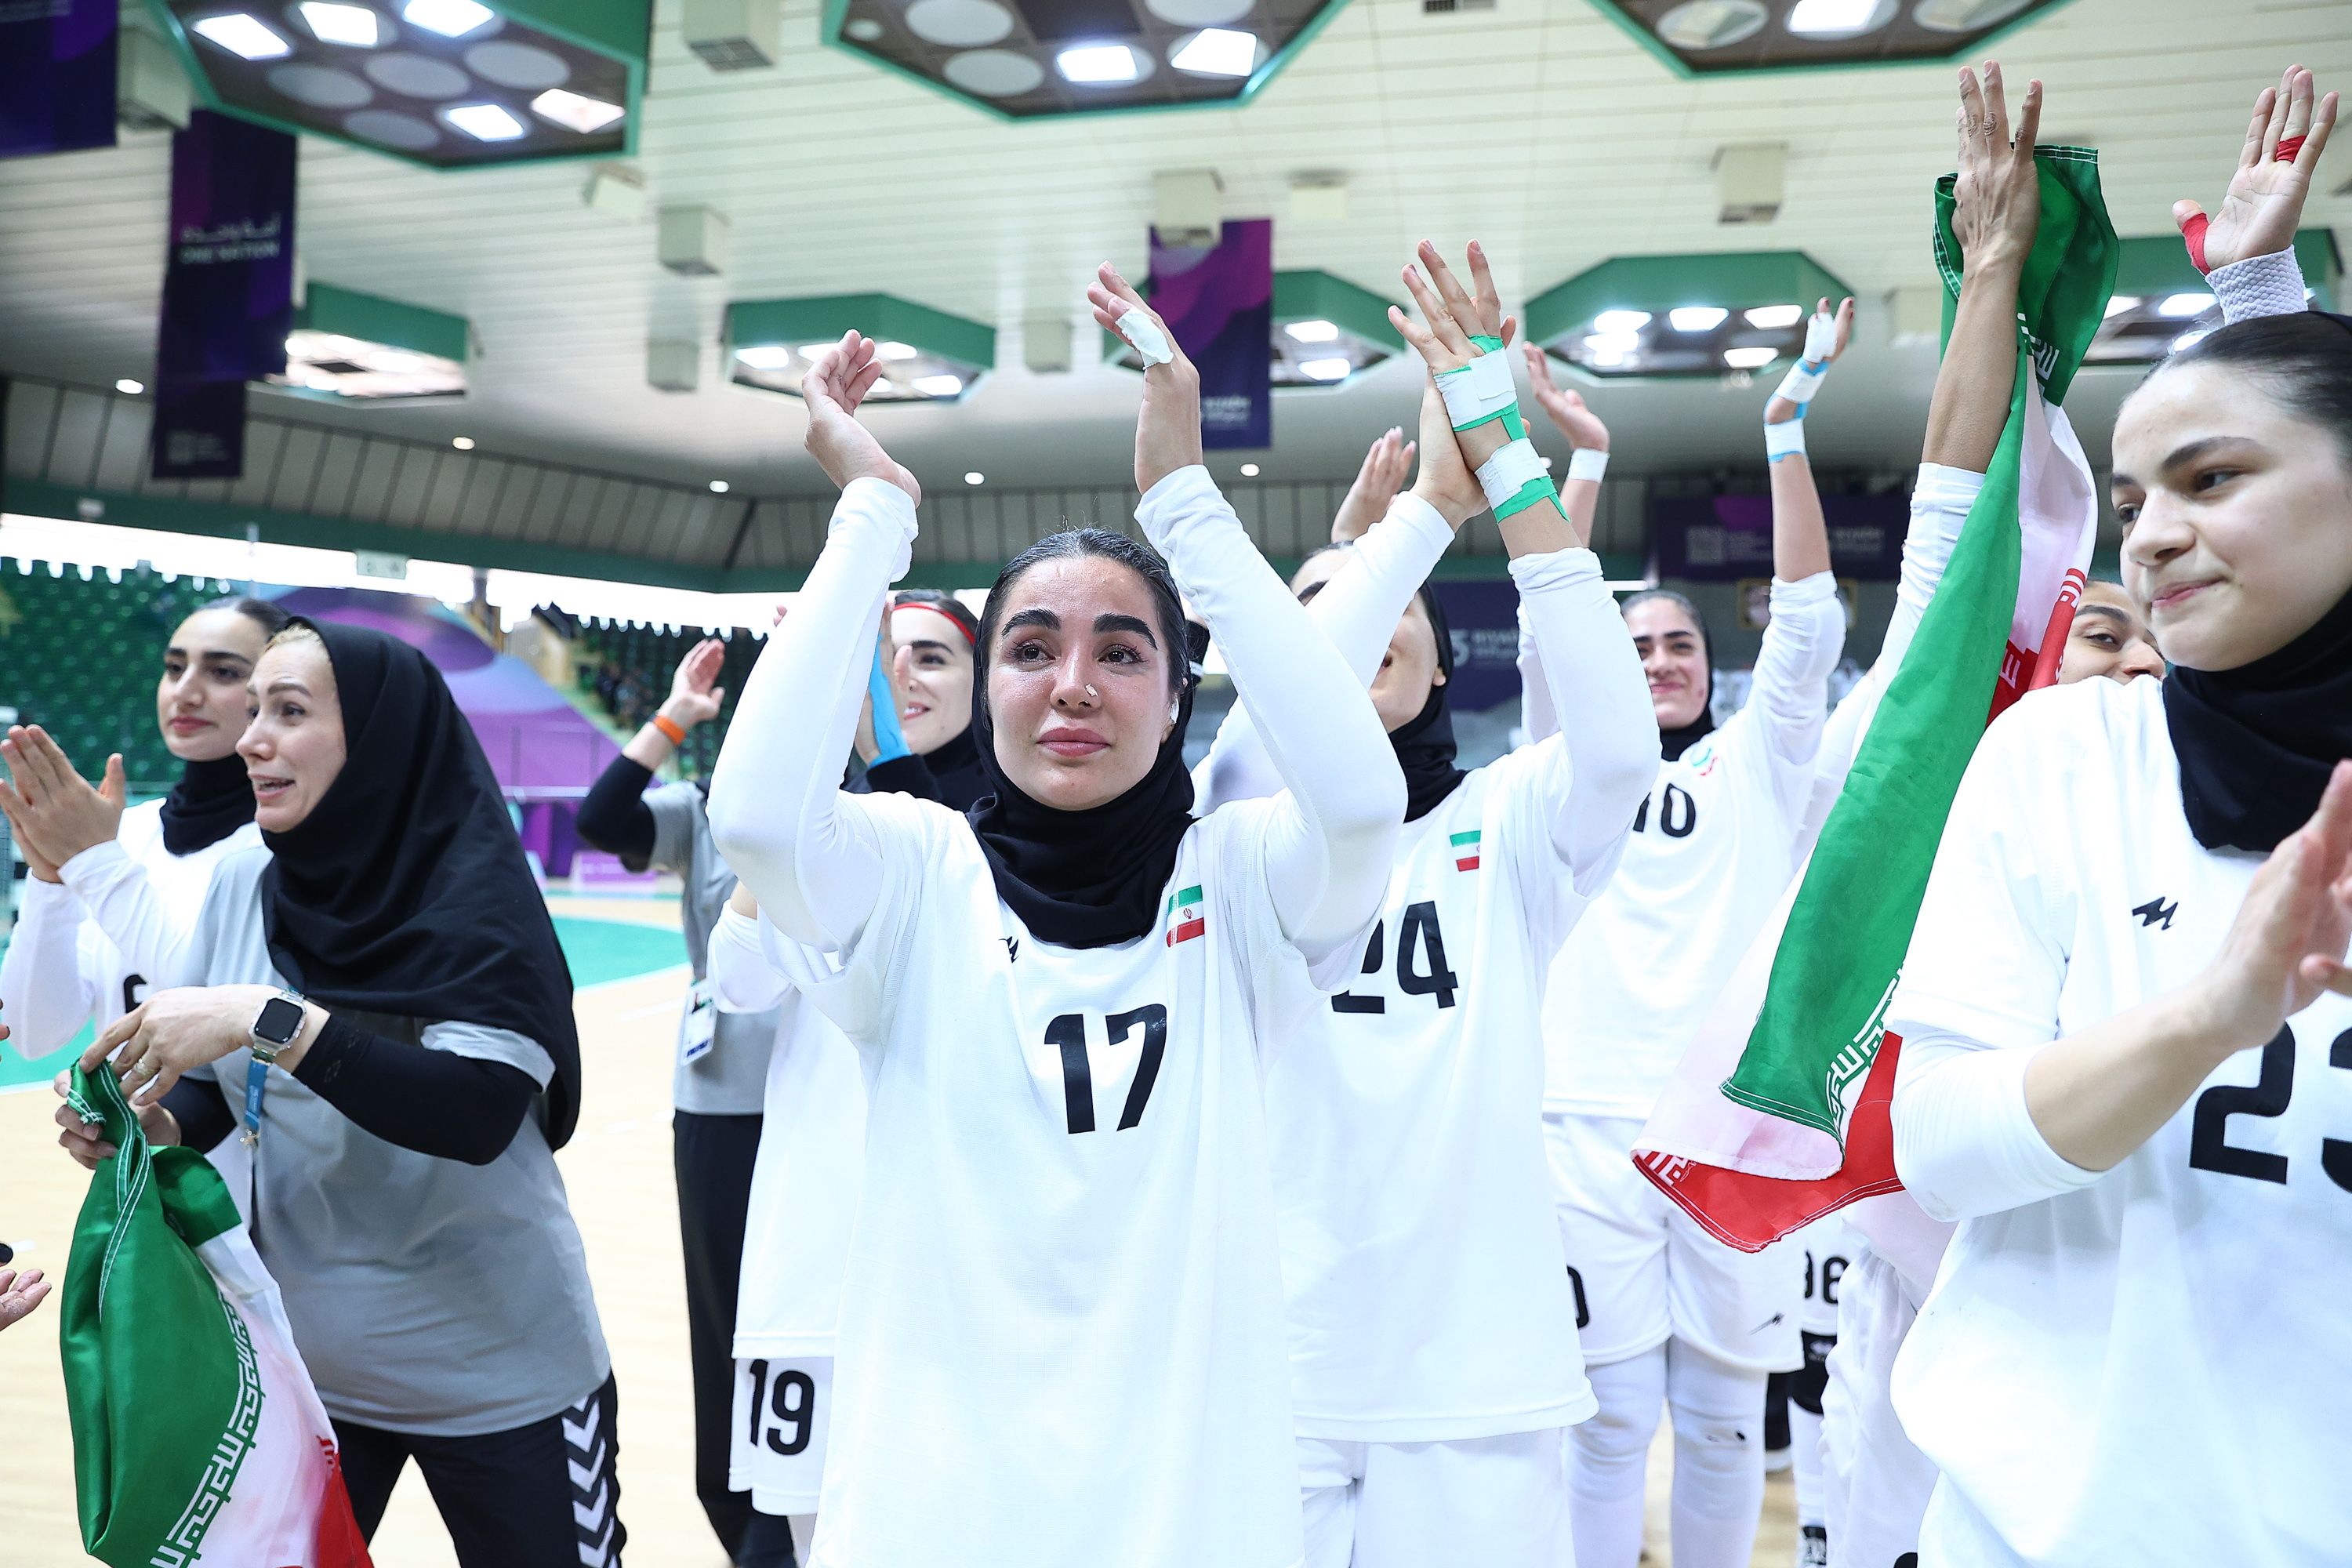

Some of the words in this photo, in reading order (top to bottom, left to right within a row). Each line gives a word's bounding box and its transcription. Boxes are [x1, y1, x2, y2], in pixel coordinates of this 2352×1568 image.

[1331, 900, 1459, 1014] 24
[1044, 1003, 1167, 1134] 17
[750, 1359, 815, 1456] 19
